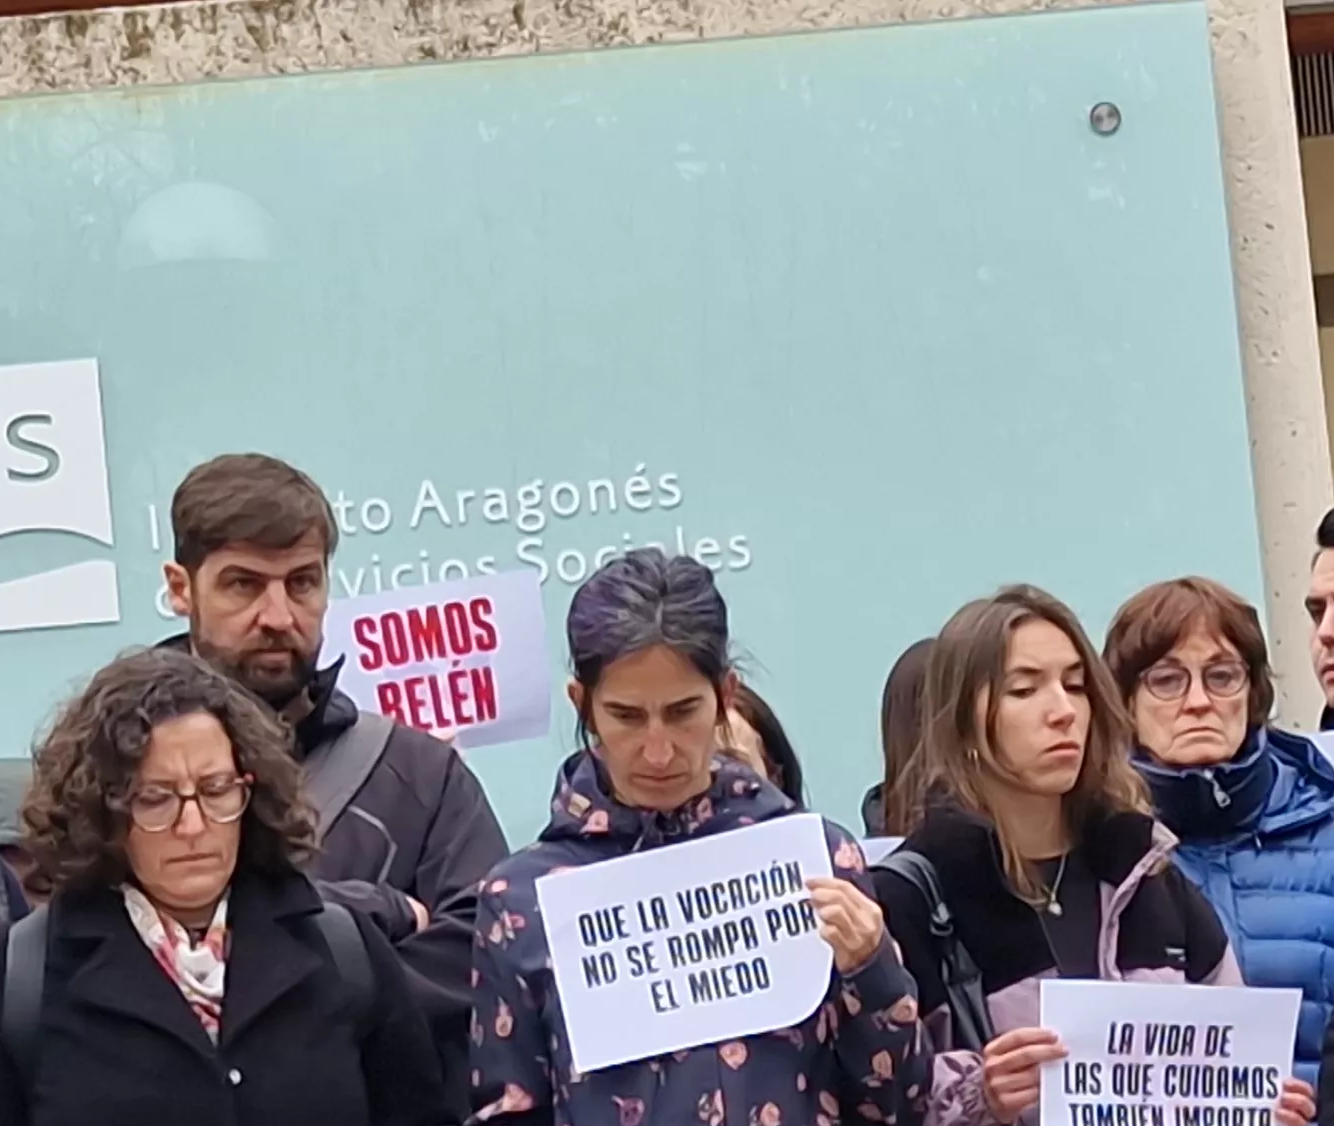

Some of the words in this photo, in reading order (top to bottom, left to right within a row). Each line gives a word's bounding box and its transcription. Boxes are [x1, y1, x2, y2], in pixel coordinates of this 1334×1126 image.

[410, 462, 683, 532] Aragonés
[337, 549, 498, 598] vicios
[353, 597, 498, 672] SOMOS
[376, 659, 497, 731] BELÉN
[578, 904, 630, 948] QUE
[637, 896, 668, 934] LA
[676, 860, 804, 924] VOCACIÓN
[581, 951, 617, 988] NO
[627, 941, 659, 978] SE
[667, 916, 759, 968] ROMPA
[765, 899, 817, 942] POR
[650, 980, 681, 1013] EL
[688, 956, 771, 1005] MIEDO
[1107, 1021, 1135, 1056] LA
[1145, 1022, 1196, 1057] VIDA
[1204, 1024, 1235, 1058] DE
[1063, 1061, 1102, 1096] LAS
[1111, 1062, 1154, 1098] QUE
[1164, 1064, 1280, 1100] CUIDAMOS
